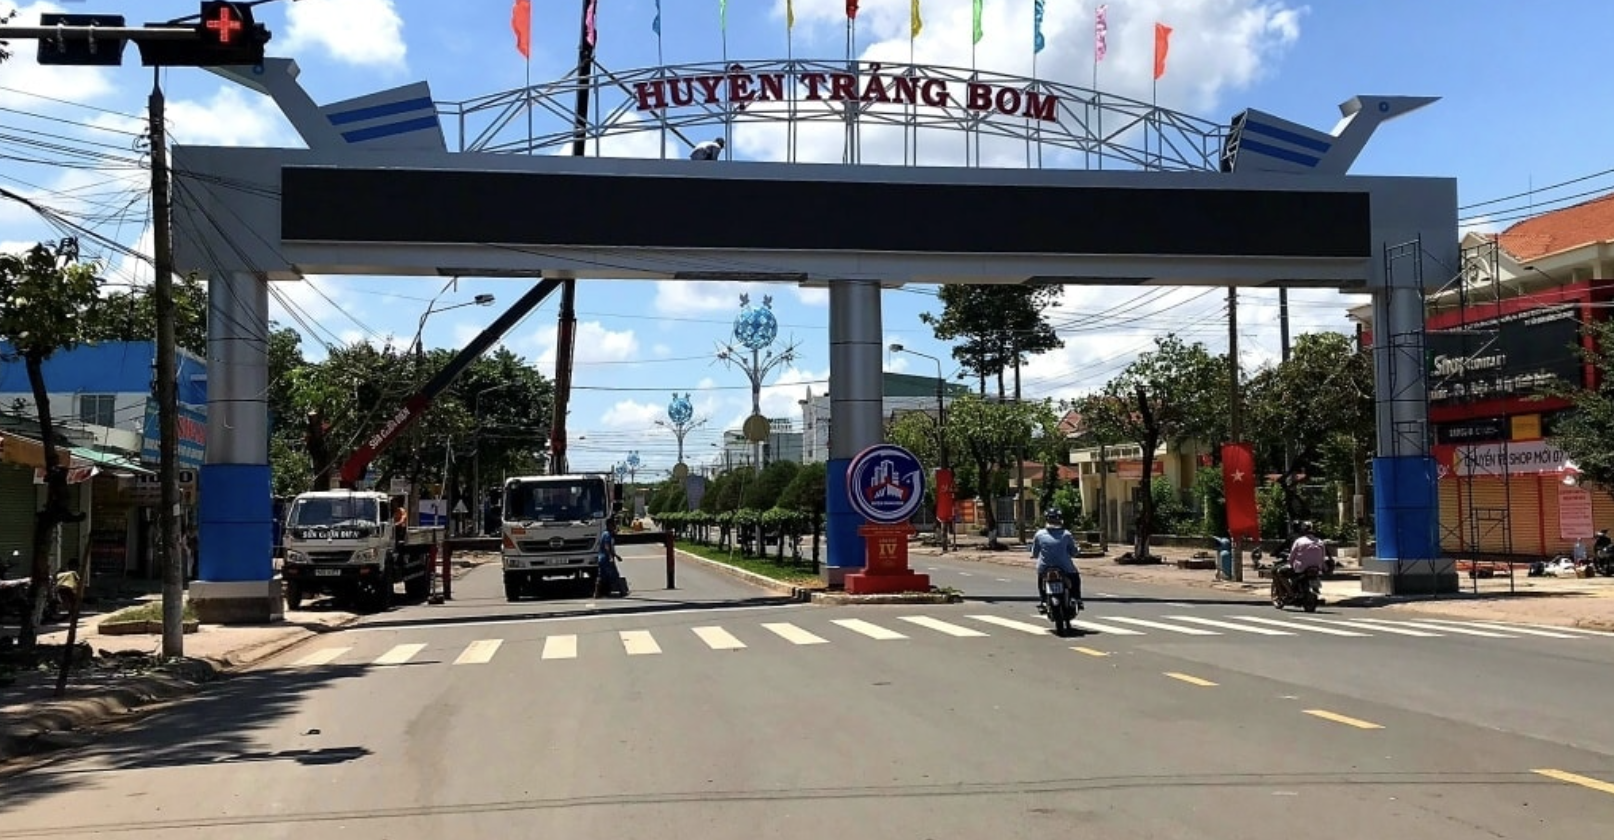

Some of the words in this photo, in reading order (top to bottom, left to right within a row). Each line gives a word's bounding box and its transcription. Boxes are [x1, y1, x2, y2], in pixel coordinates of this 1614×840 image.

[634, 62, 785, 112] HUYỆN
[800, 62, 949, 108] TRẢNG
[966, 81, 1059, 122] BOM
[1509, 451, 1532, 465] SHOP
[878, 543, 898, 556] IV
